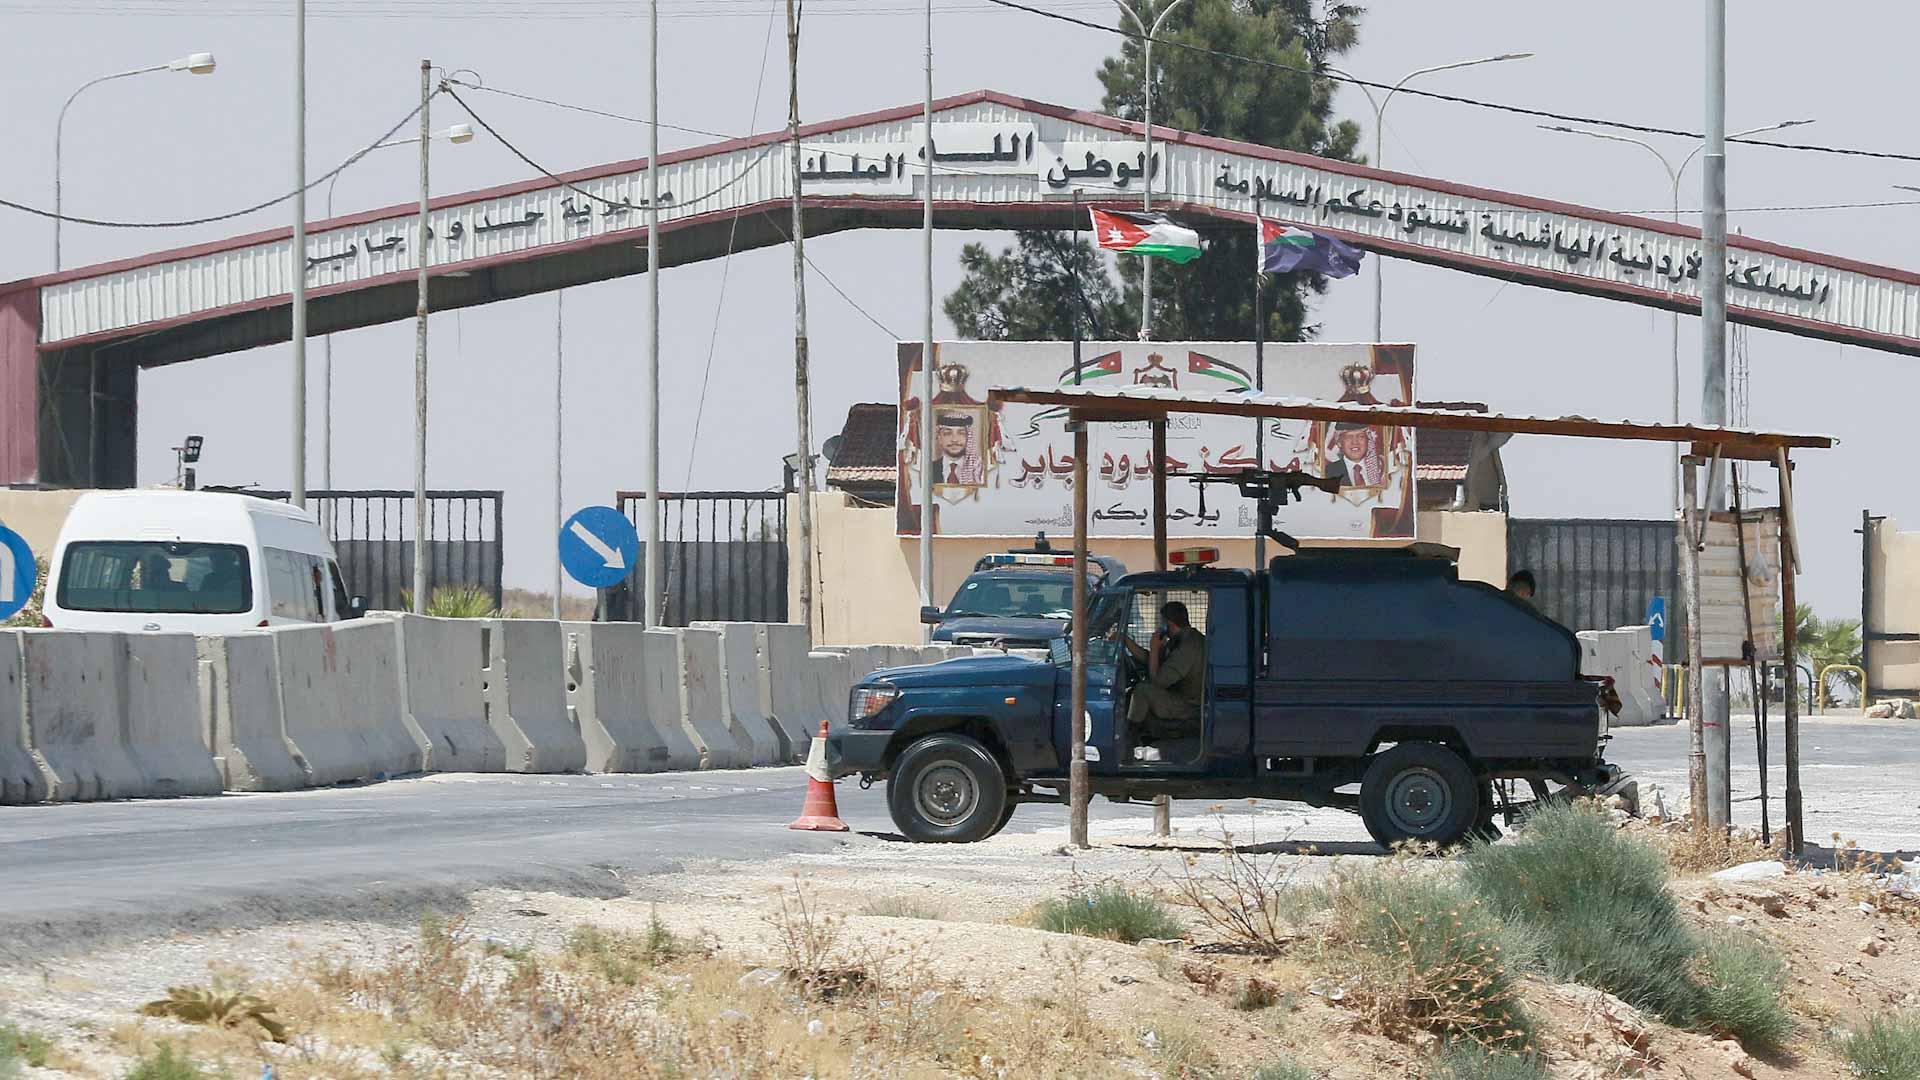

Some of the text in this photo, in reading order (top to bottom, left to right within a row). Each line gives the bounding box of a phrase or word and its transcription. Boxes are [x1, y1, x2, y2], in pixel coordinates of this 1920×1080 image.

[919, 130, 1033, 162] الله
[800, 151, 904, 183] الملك
[1047, 150, 1159, 187] الوطن
[1214, 163, 1829, 305] المملكة لأردنية الهاشمية تستودعكم السلامة
[1009, 443, 1088, 485] جابر
[1100, 450, 1188, 487] حدود
[1092, 502, 1220, 527] يرح بكم
